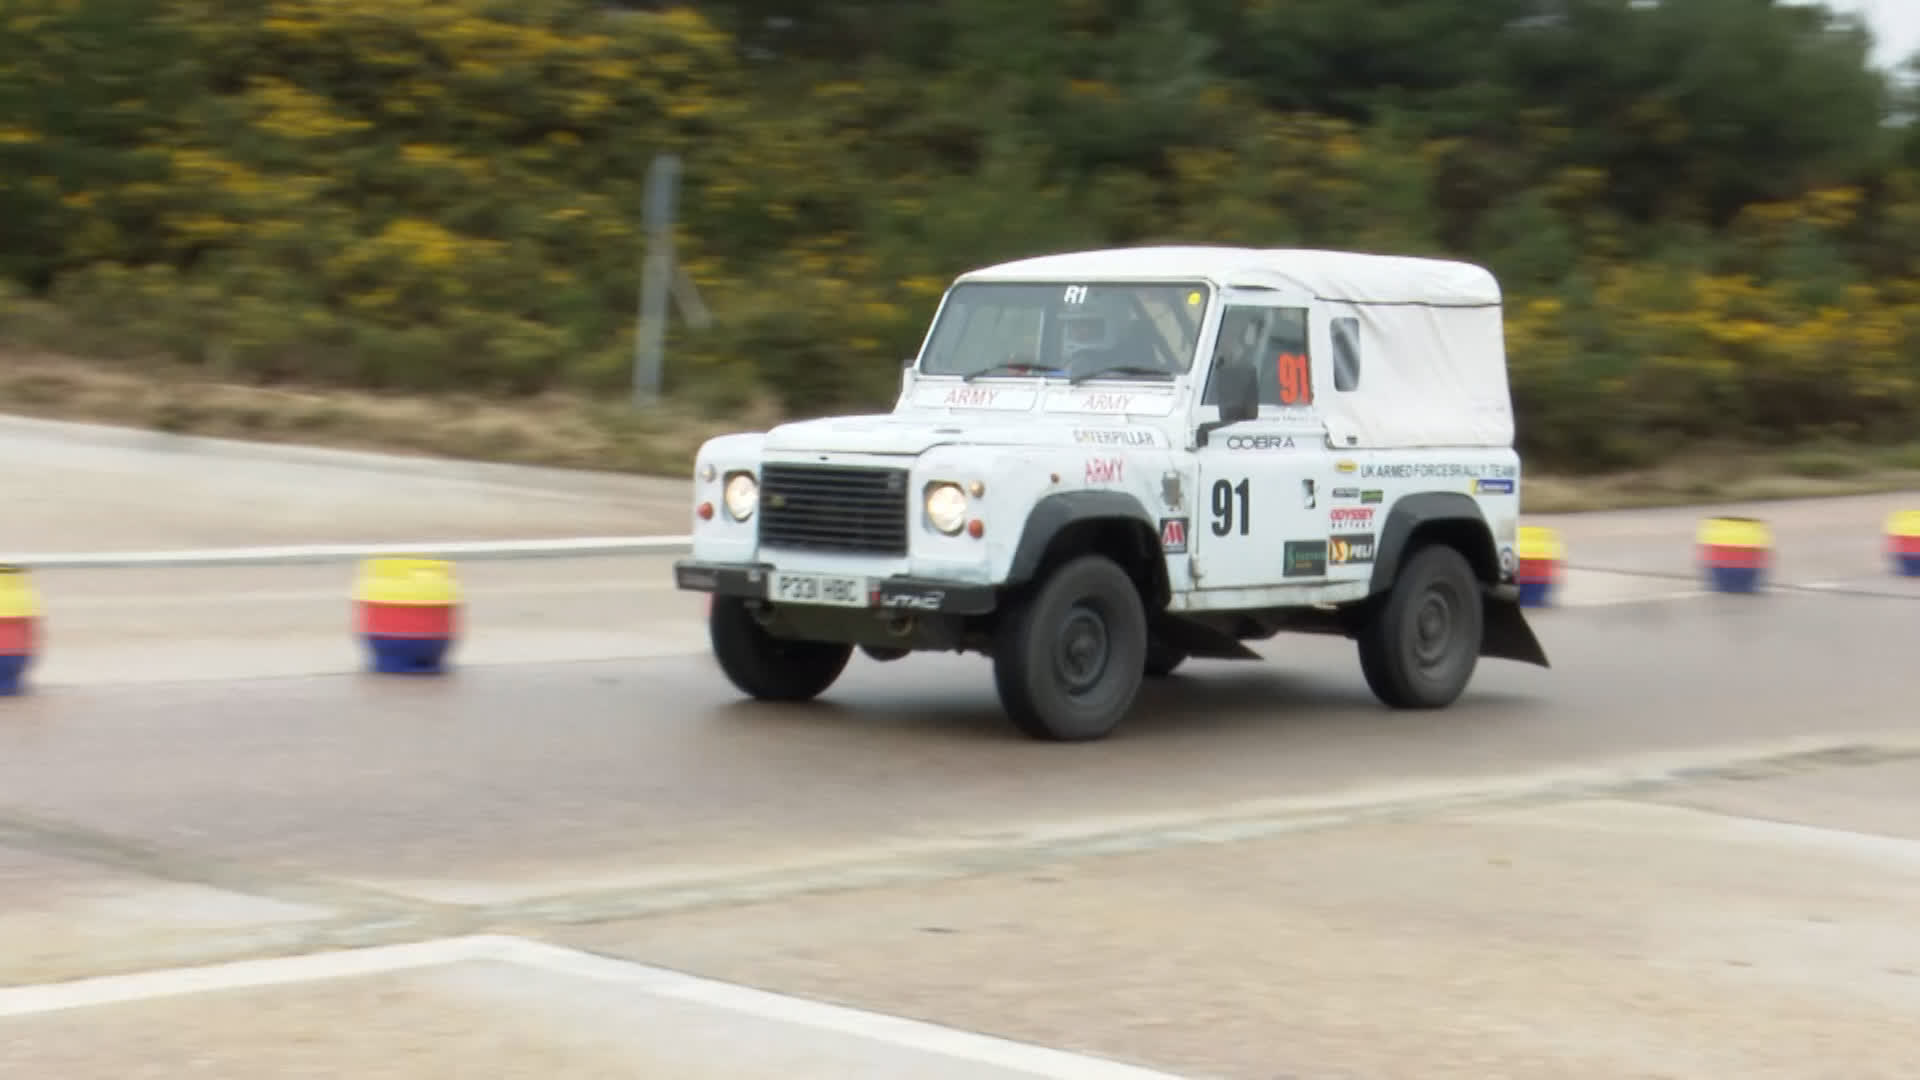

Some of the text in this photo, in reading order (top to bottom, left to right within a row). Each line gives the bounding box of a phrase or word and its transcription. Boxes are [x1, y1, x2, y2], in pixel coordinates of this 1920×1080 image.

[1063, 285, 1088, 304] R1
[1278, 352, 1310, 405] 91
[944, 387, 998, 406] ARMY
[1082, 393, 1136, 411] ARMY
[1073, 428, 1155, 446] CATERPILLAR
[1226, 435, 1296, 450] COBRA
[1085, 457, 1123, 483] ARMY
[1360, 464, 1375, 478] UK
[1376, 464, 1413, 478] ARMED
[1415, 464, 1455, 478] FORCES
[1455, 463, 1486, 477] RALLY
[1488, 463, 1515, 477] TEAM
[1212, 477, 1249, 537] 91
[1330, 508, 1374, 520] ODYSSEY
